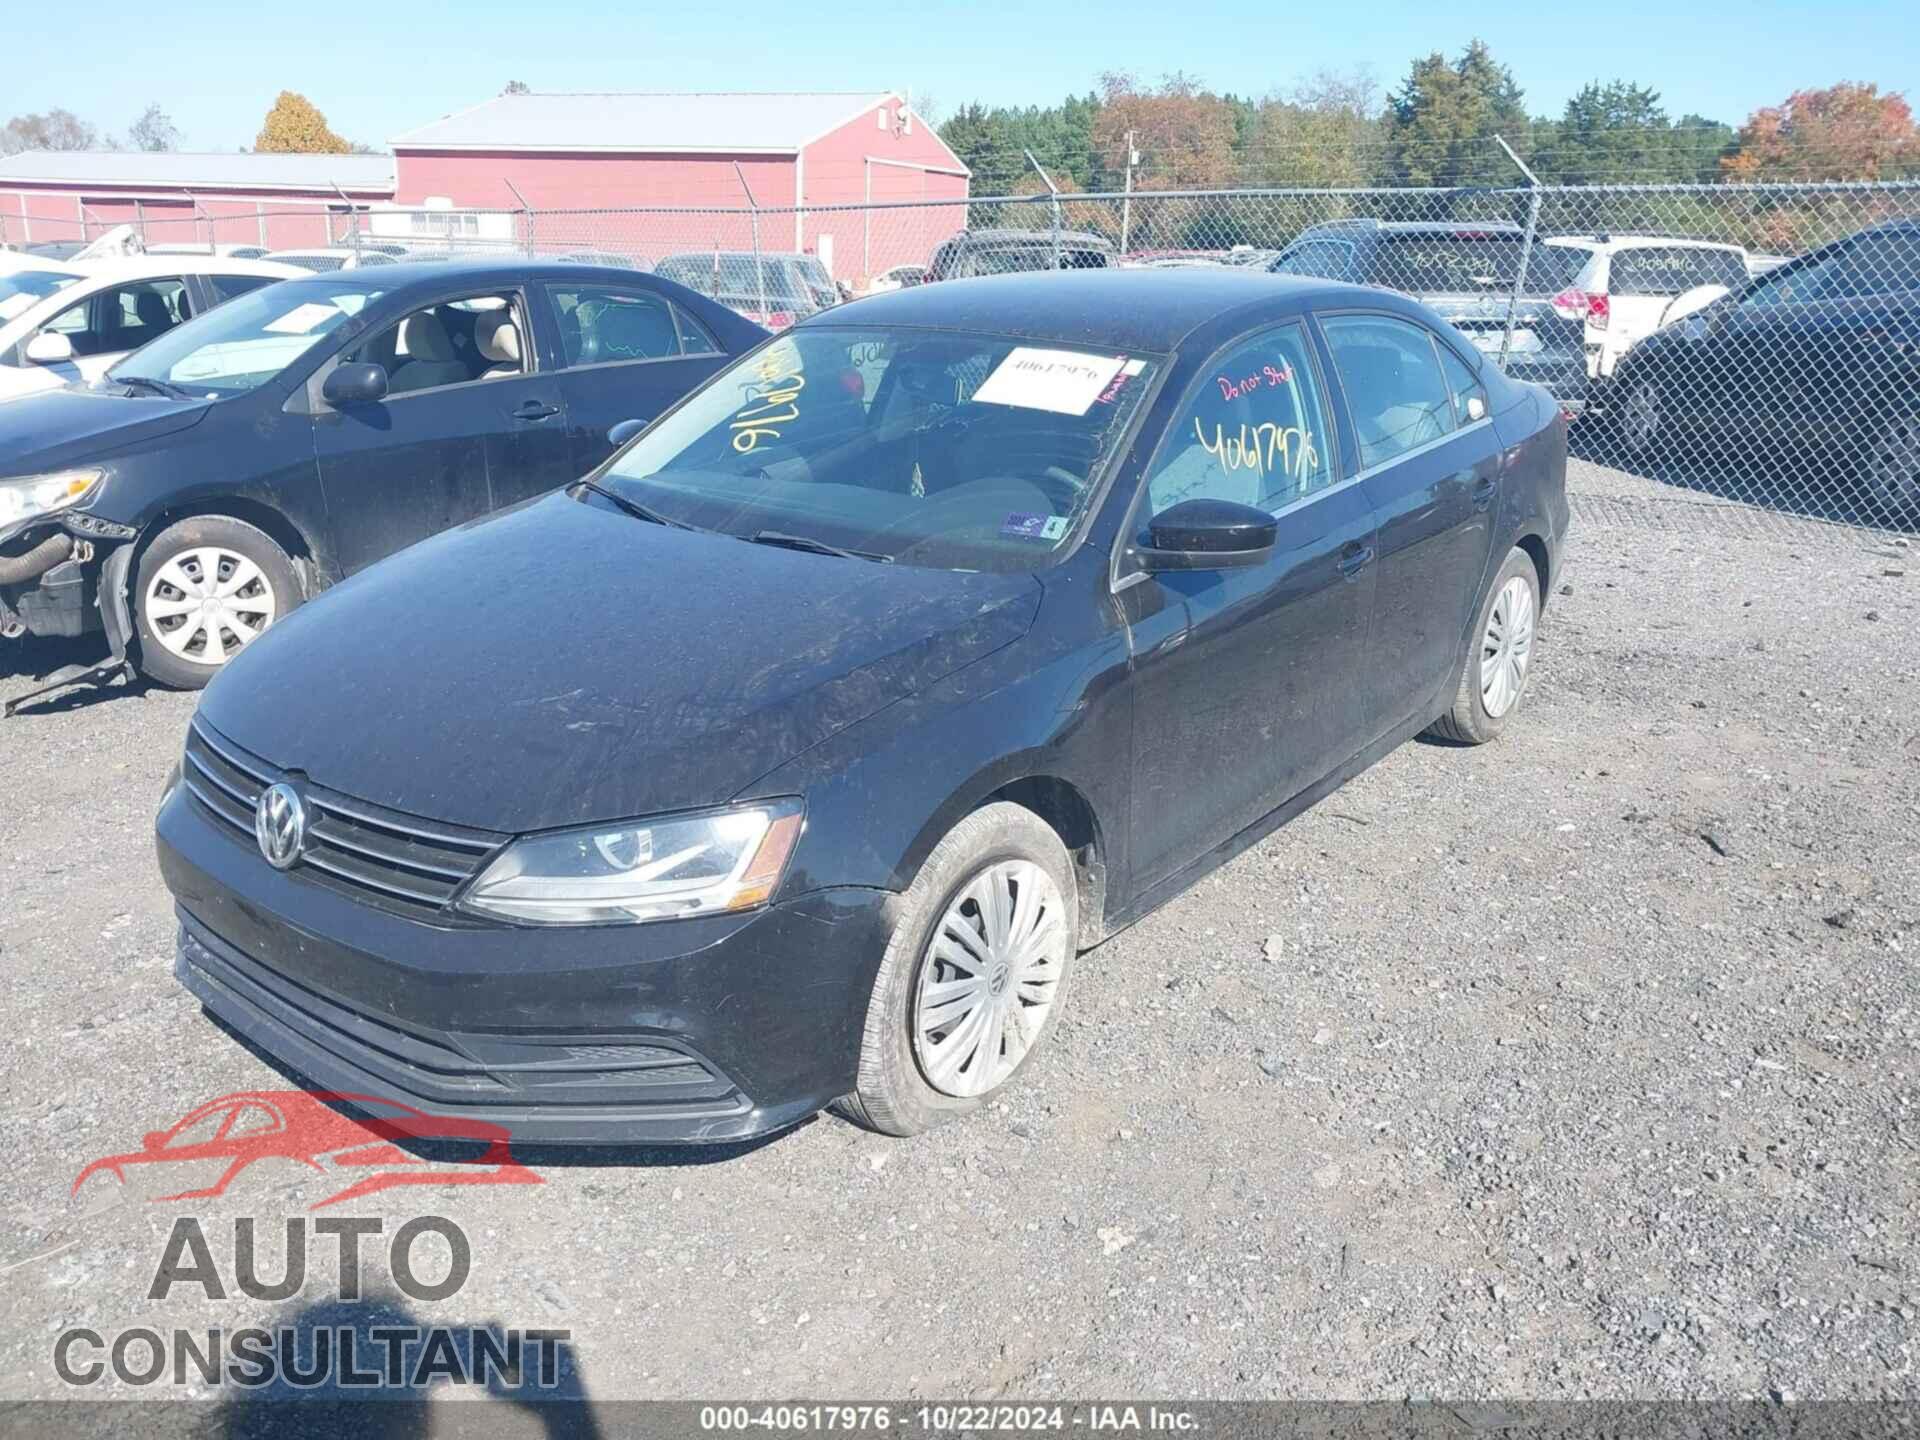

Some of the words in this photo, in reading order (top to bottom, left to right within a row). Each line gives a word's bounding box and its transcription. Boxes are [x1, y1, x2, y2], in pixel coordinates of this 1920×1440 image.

[1218, 376, 1238, 401] Do
[1239, 373, 1262, 395] not
[1195, 416, 1319, 478] 40617976
